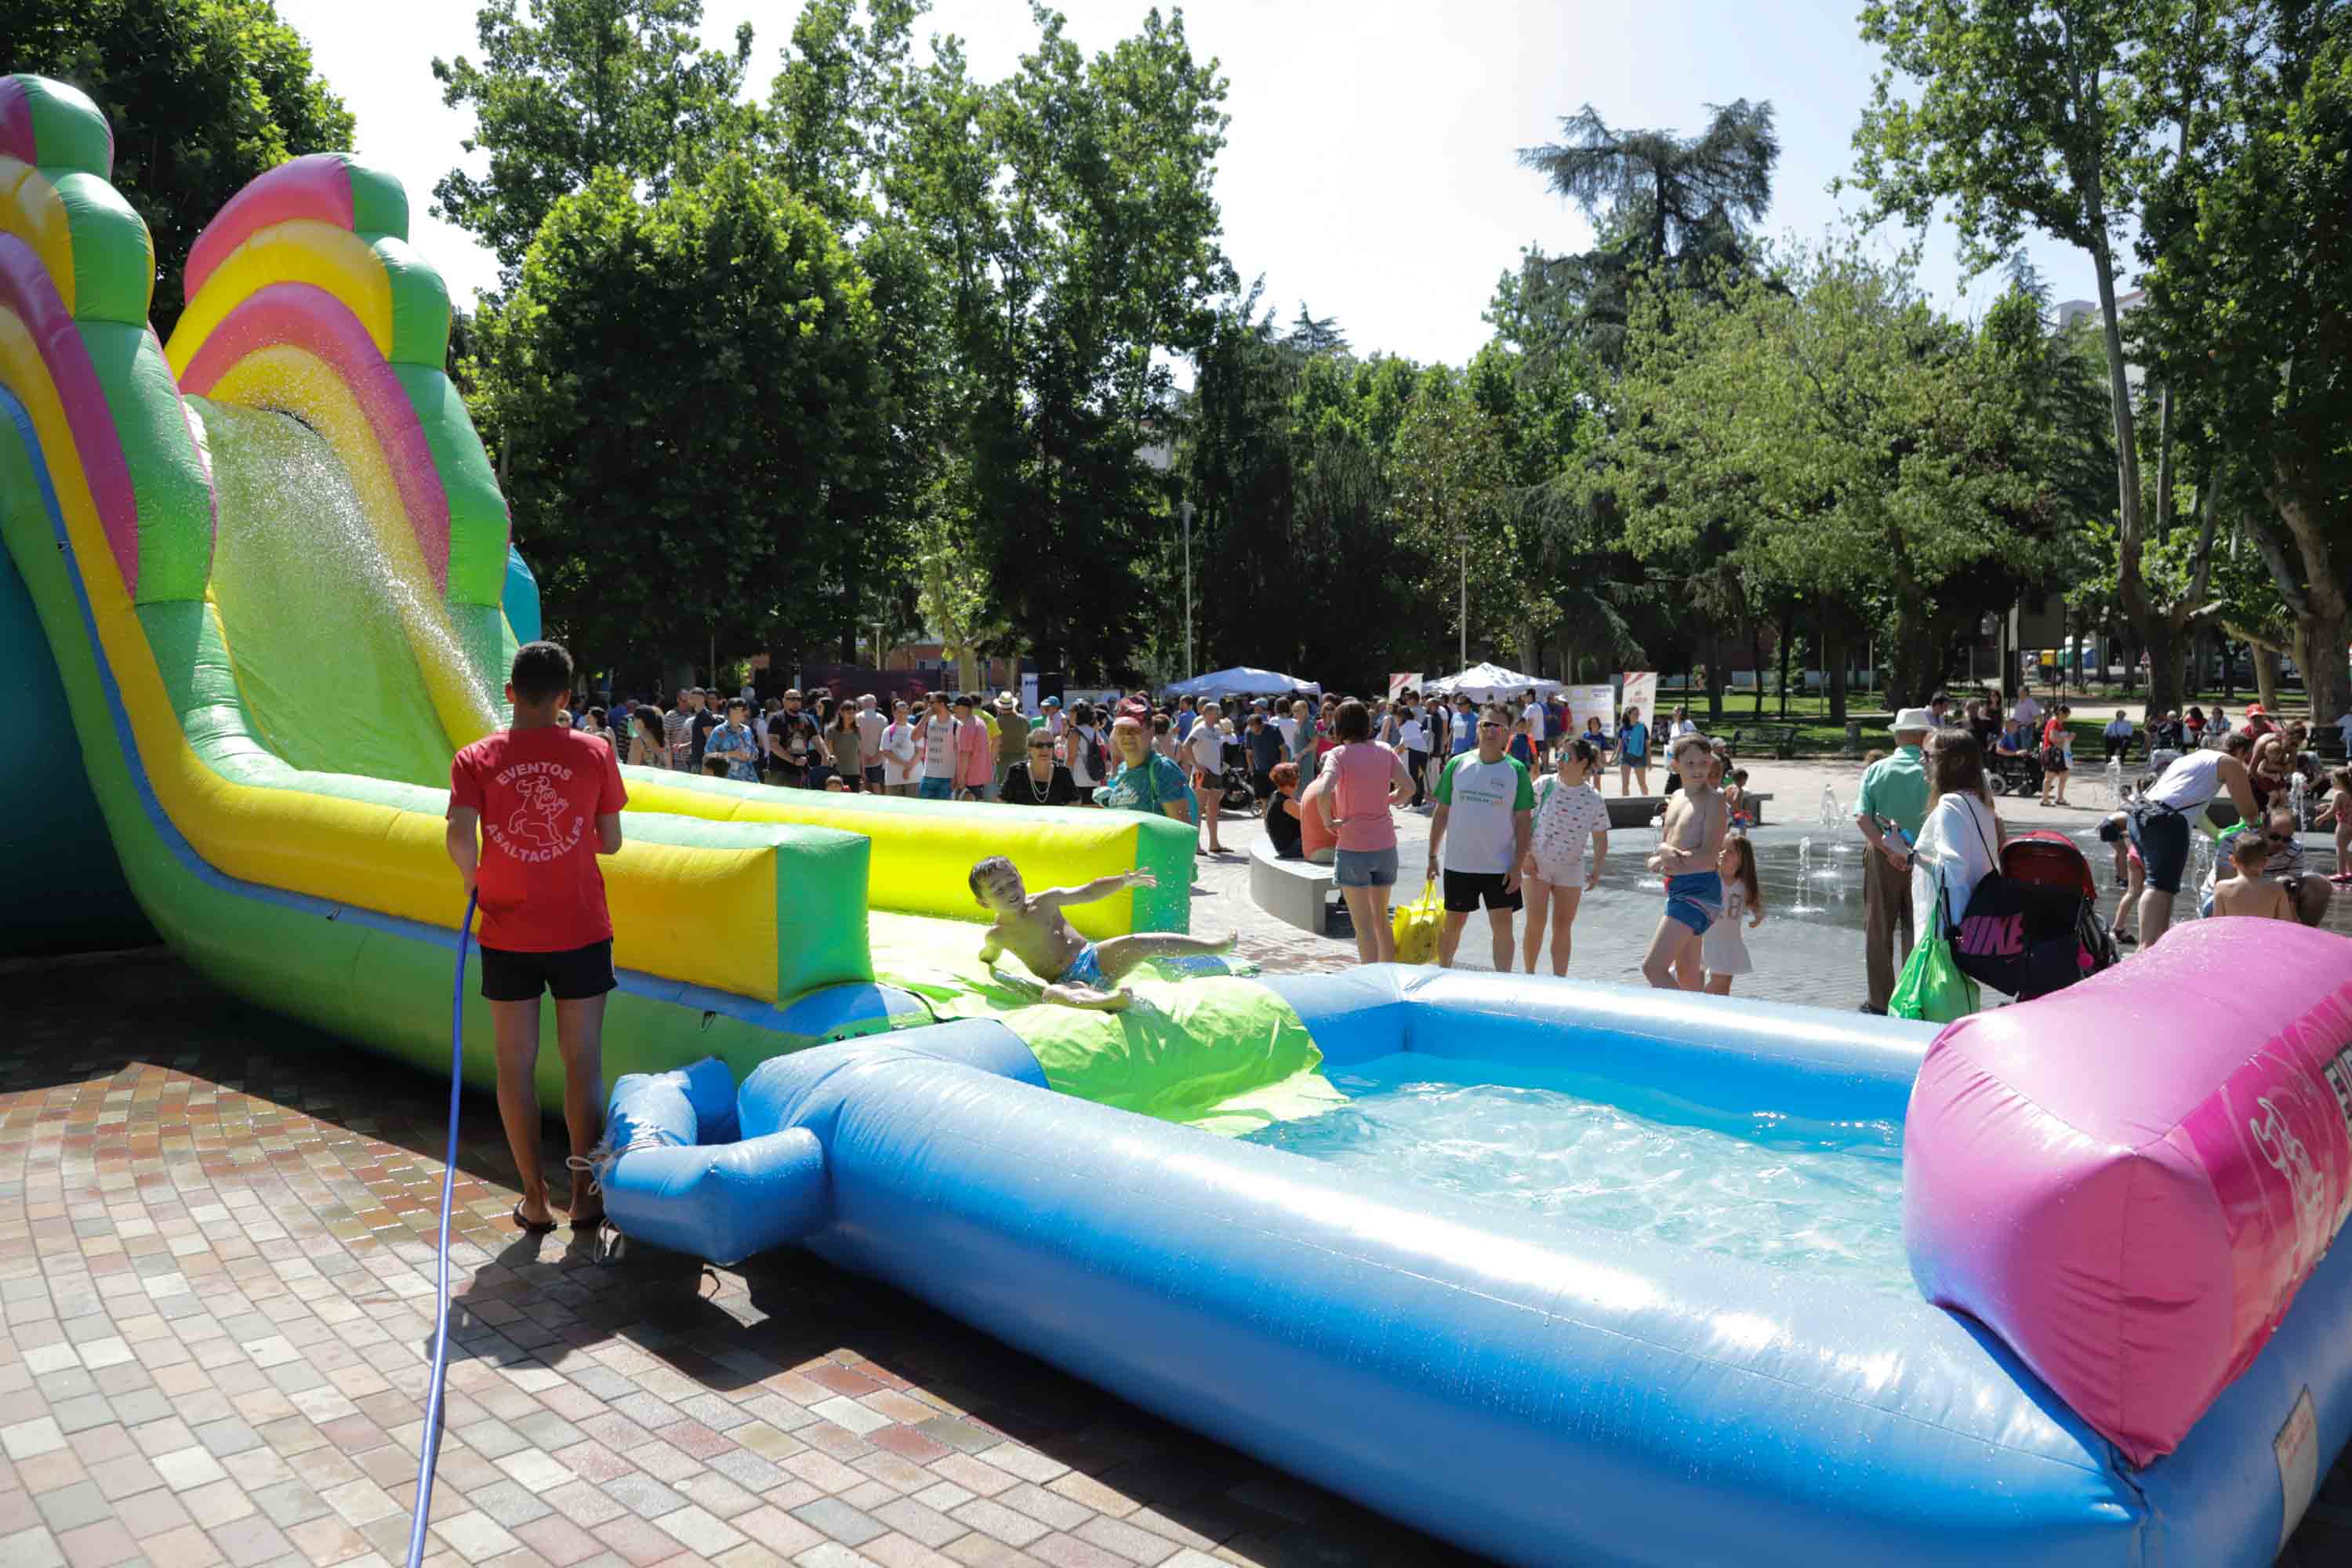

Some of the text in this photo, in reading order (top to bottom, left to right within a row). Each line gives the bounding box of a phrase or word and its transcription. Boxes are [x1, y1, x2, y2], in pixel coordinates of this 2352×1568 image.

[495, 761, 573, 785] EVENTOS
[485, 815, 584, 862] ASALTACALLES
[1960, 914, 2025, 955] NIKE
